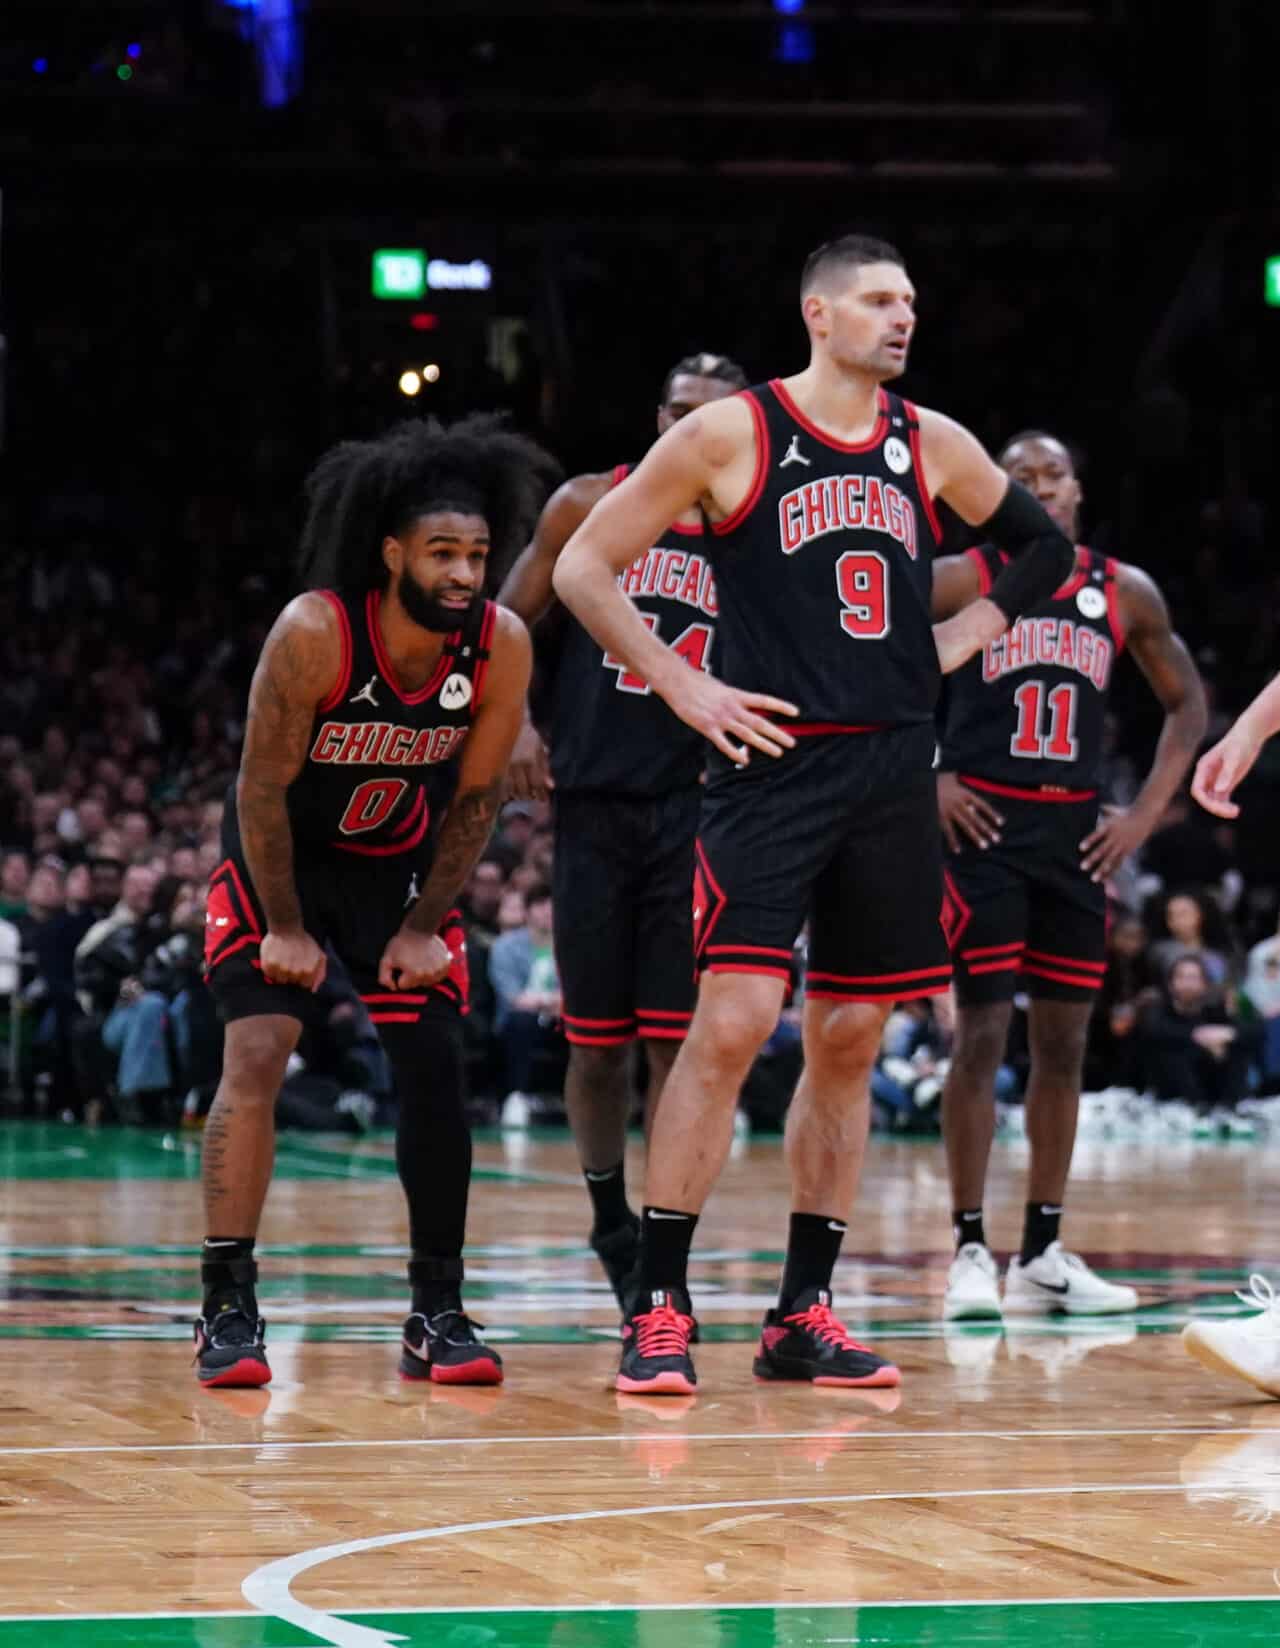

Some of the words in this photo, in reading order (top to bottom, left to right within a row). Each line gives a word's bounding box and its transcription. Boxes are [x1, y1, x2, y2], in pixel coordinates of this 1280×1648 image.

[778, 474, 919, 561] CHICAGO
[616, 547, 720, 618] HICAG
[835, 550, 890, 640] 9
[981, 616, 1112, 692] CHICAGO
[1010, 679, 1079, 762] 11
[338, 777, 409, 835] 0
